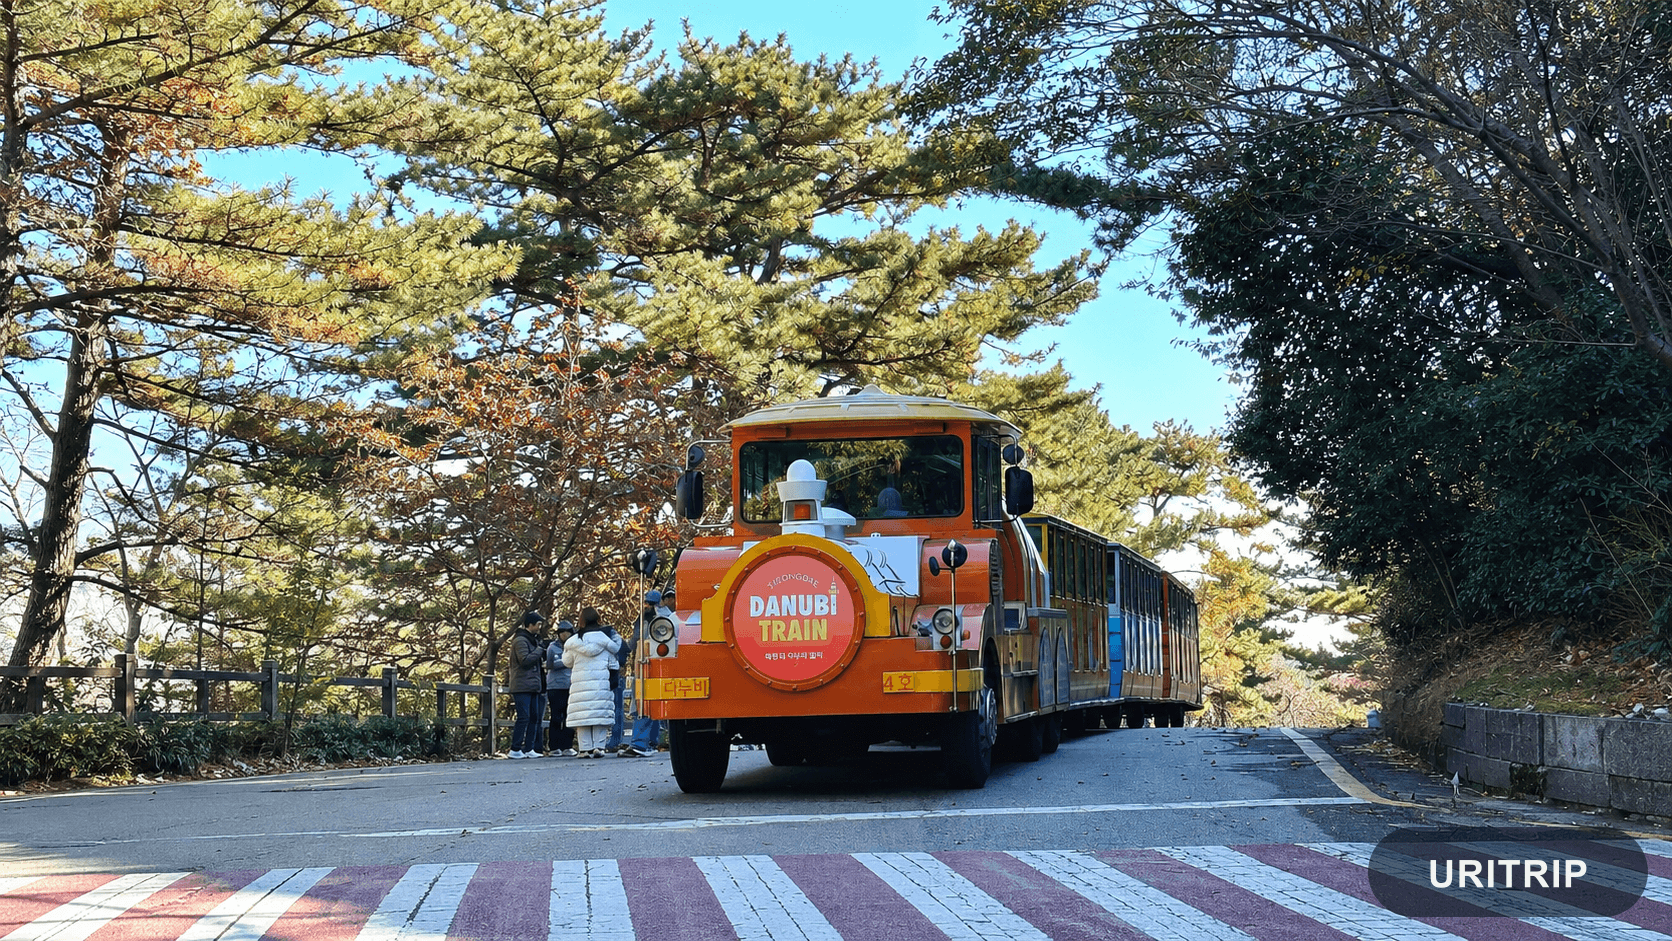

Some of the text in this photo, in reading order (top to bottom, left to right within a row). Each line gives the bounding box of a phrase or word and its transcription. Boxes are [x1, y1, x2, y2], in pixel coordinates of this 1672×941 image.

[750, 594, 837, 617] DANUBI
[758, 618, 828, 642] TRAIN
[664, 680, 707, 698] 다누비
